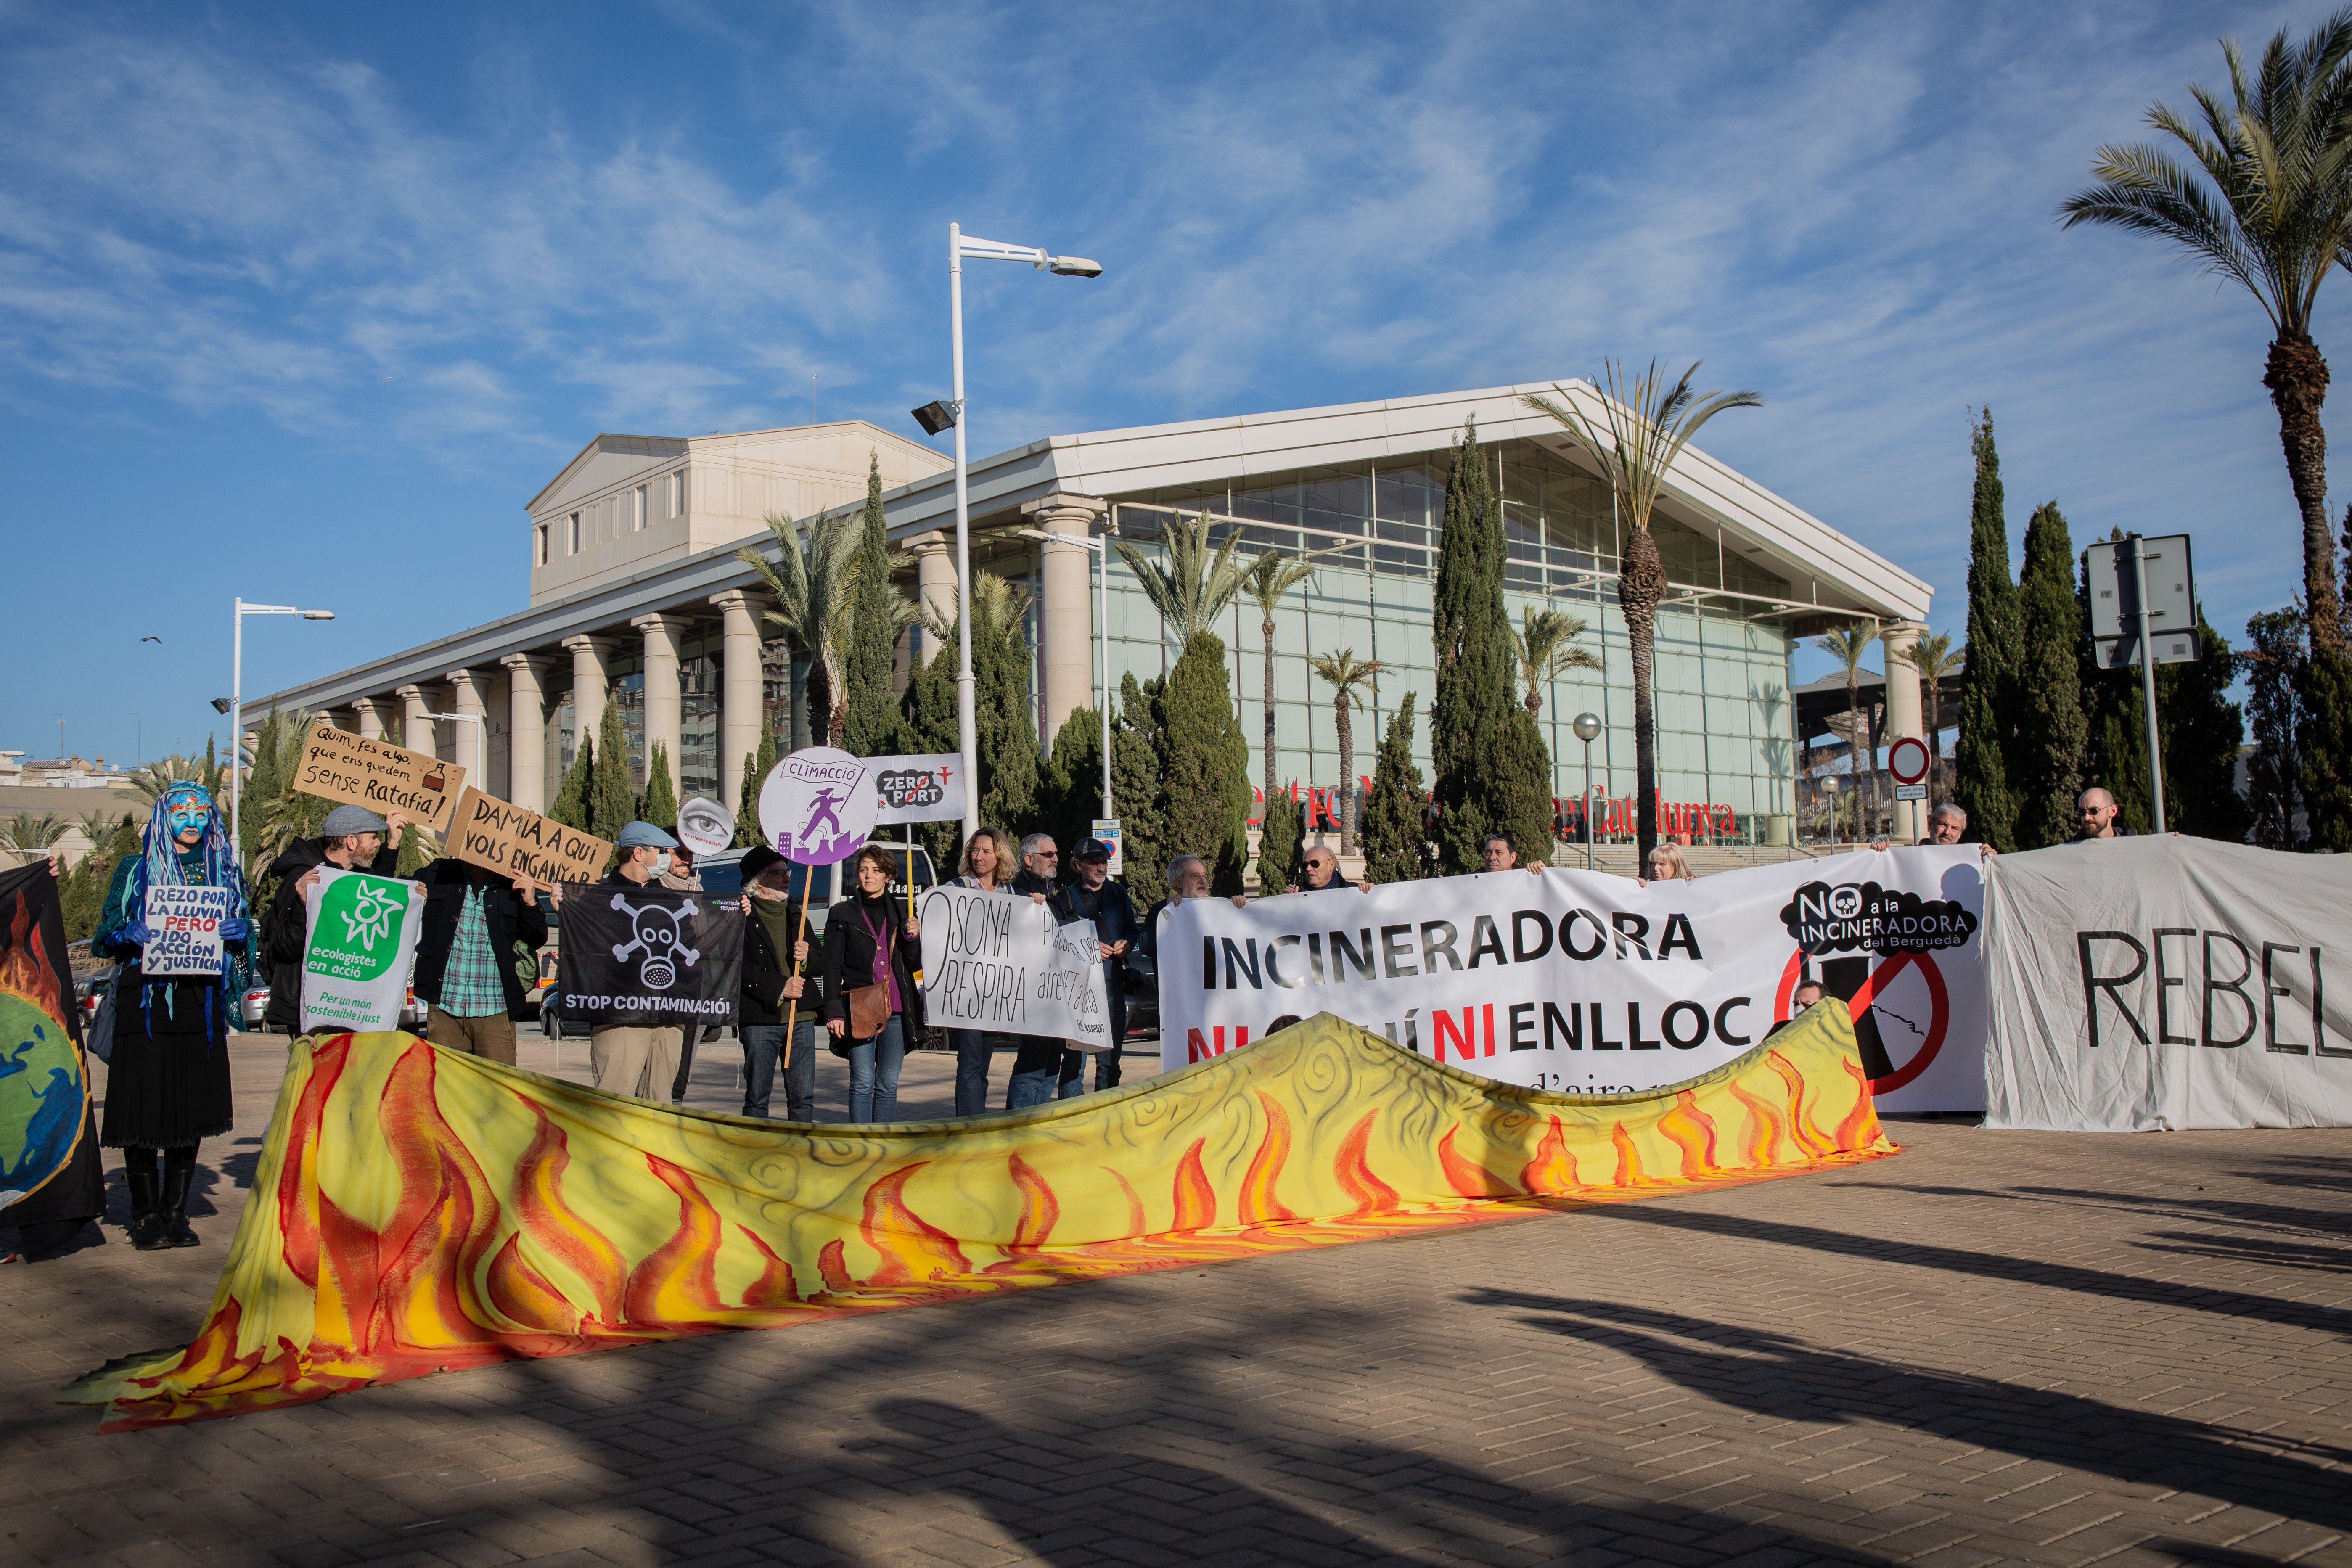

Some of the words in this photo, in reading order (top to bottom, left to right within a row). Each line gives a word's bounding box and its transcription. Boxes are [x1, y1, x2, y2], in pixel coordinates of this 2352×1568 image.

[317, 728, 355, 750] Quim,
[357, 740, 377, 753] fes
[382, 750, 411, 765] algo,
[310, 746, 337, 762] que
[342, 755, 362, 767] ens
[366, 762, 411, 782] quedem
[883, 776, 929, 791] ZERO
[364, 779, 447, 823] Ratafia!
[894, 789, 938, 803] PORT
[1583, 785, 1736, 846] Catlunya
[466, 830, 508, 864] VOLS
[546, 828, 561, 853] A
[154, 888, 198, 902] REZO
[201, 891, 226, 906] POR
[1870, 901, 1879, 913] a
[1885, 899, 1899, 913] la
[147, 902, 169, 915] LA
[174, 905, 223, 920] LLUVIA
[165, 916, 216, 932] PERO
[1802, 915, 1968, 943] INCINERADORA
[149, 929, 191, 944] PIDO
[921, 891, 1011, 992] OSONA
[1864, 938, 1884, 948] del
[1890, 934, 1961, 948] Berguedà
[151, 940, 215, 957] ACCIÓN
[312, 947, 377, 967] ecologistes
[1203, 908, 1703, 990] INCINERADORA
[147, 957, 161, 971] Y
[163, 956, 222, 971] JUSTICIA
[308, 960, 327, 971] en
[331, 966, 361, 978] acció
[319, 992, 337, 1004] Per
[339, 997, 350, 1006] un
[352, 997, 372, 1009] món
[942, 959, 1025, 1023] RESPIRA
[566, 994, 611, 1009] STOP
[614, 996, 730, 1014] CONTAMINACIÓ!
[307, 1005, 356, 1020] sostenible
[358, 1011, 362, 1020] i
[361, 1012, 381, 1024] just
[1432, 1003, 1495, 1063] NI
[1509, 997, 1751, 1052] ENLLOC
